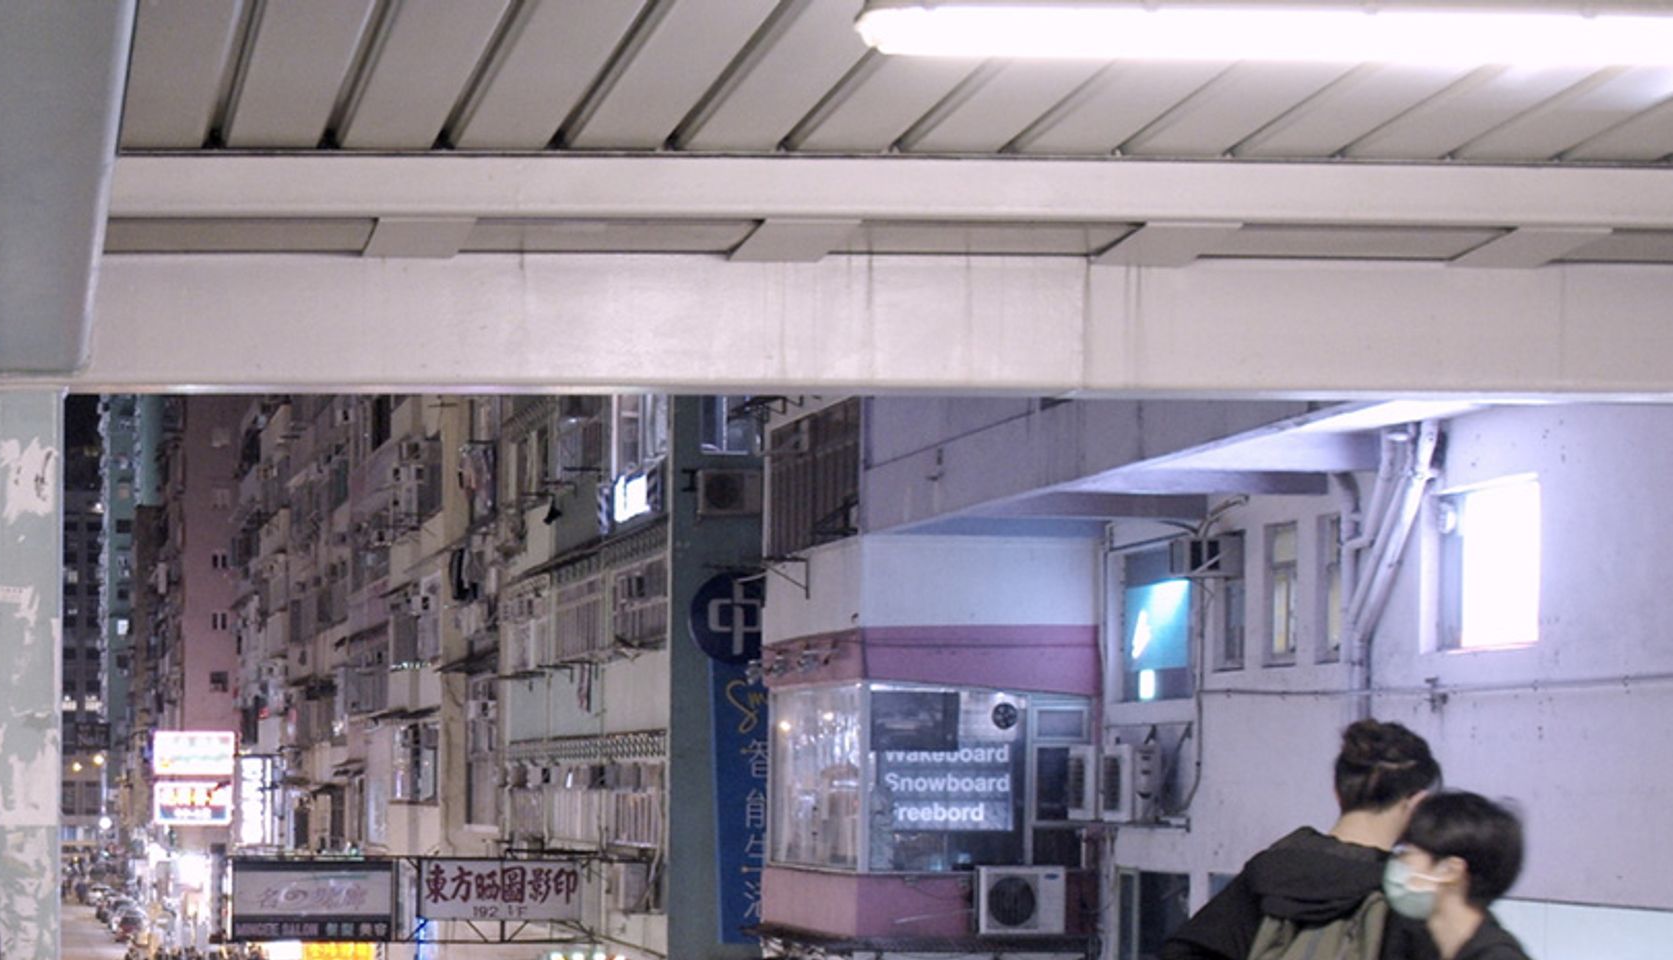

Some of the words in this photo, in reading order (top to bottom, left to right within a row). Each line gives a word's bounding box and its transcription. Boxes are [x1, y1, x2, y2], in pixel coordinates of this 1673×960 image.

[885, 743, 1010, 763] Wakeboard
[884, 772, 1011, 792] Snowboard
[892, 802, 985, 821] reebord
[425, 864, 578, 904] 東方晒圖影印
